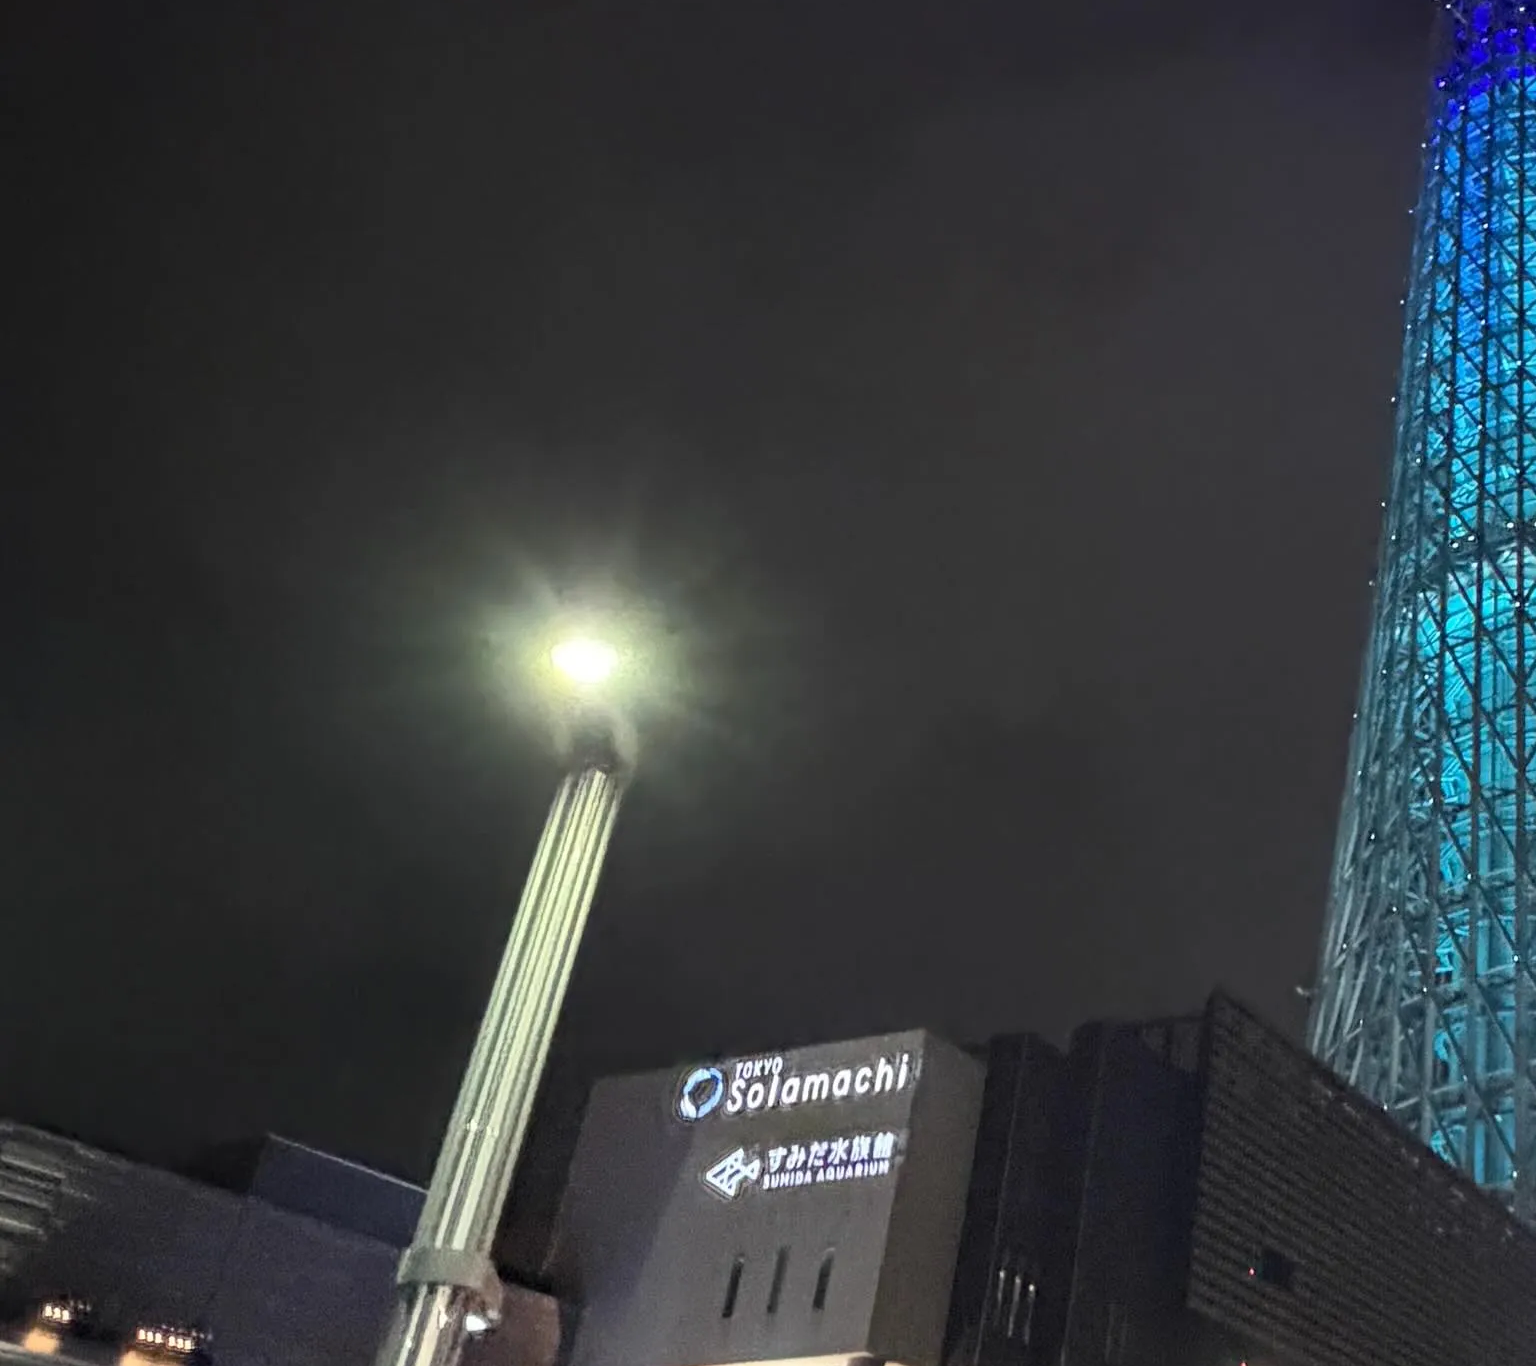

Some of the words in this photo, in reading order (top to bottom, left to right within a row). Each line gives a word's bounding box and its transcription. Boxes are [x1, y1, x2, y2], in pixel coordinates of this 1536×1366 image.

[726, 1053, 910, 1113] Solamachi
[735, 1056, 783, 1080] TOKYO
[767, 1131, 895, 1172] すみだ水族館
[762, 1168, 813, 1190] SUMIDA
[815, 1159, 890, 1183] AQUARIUM
